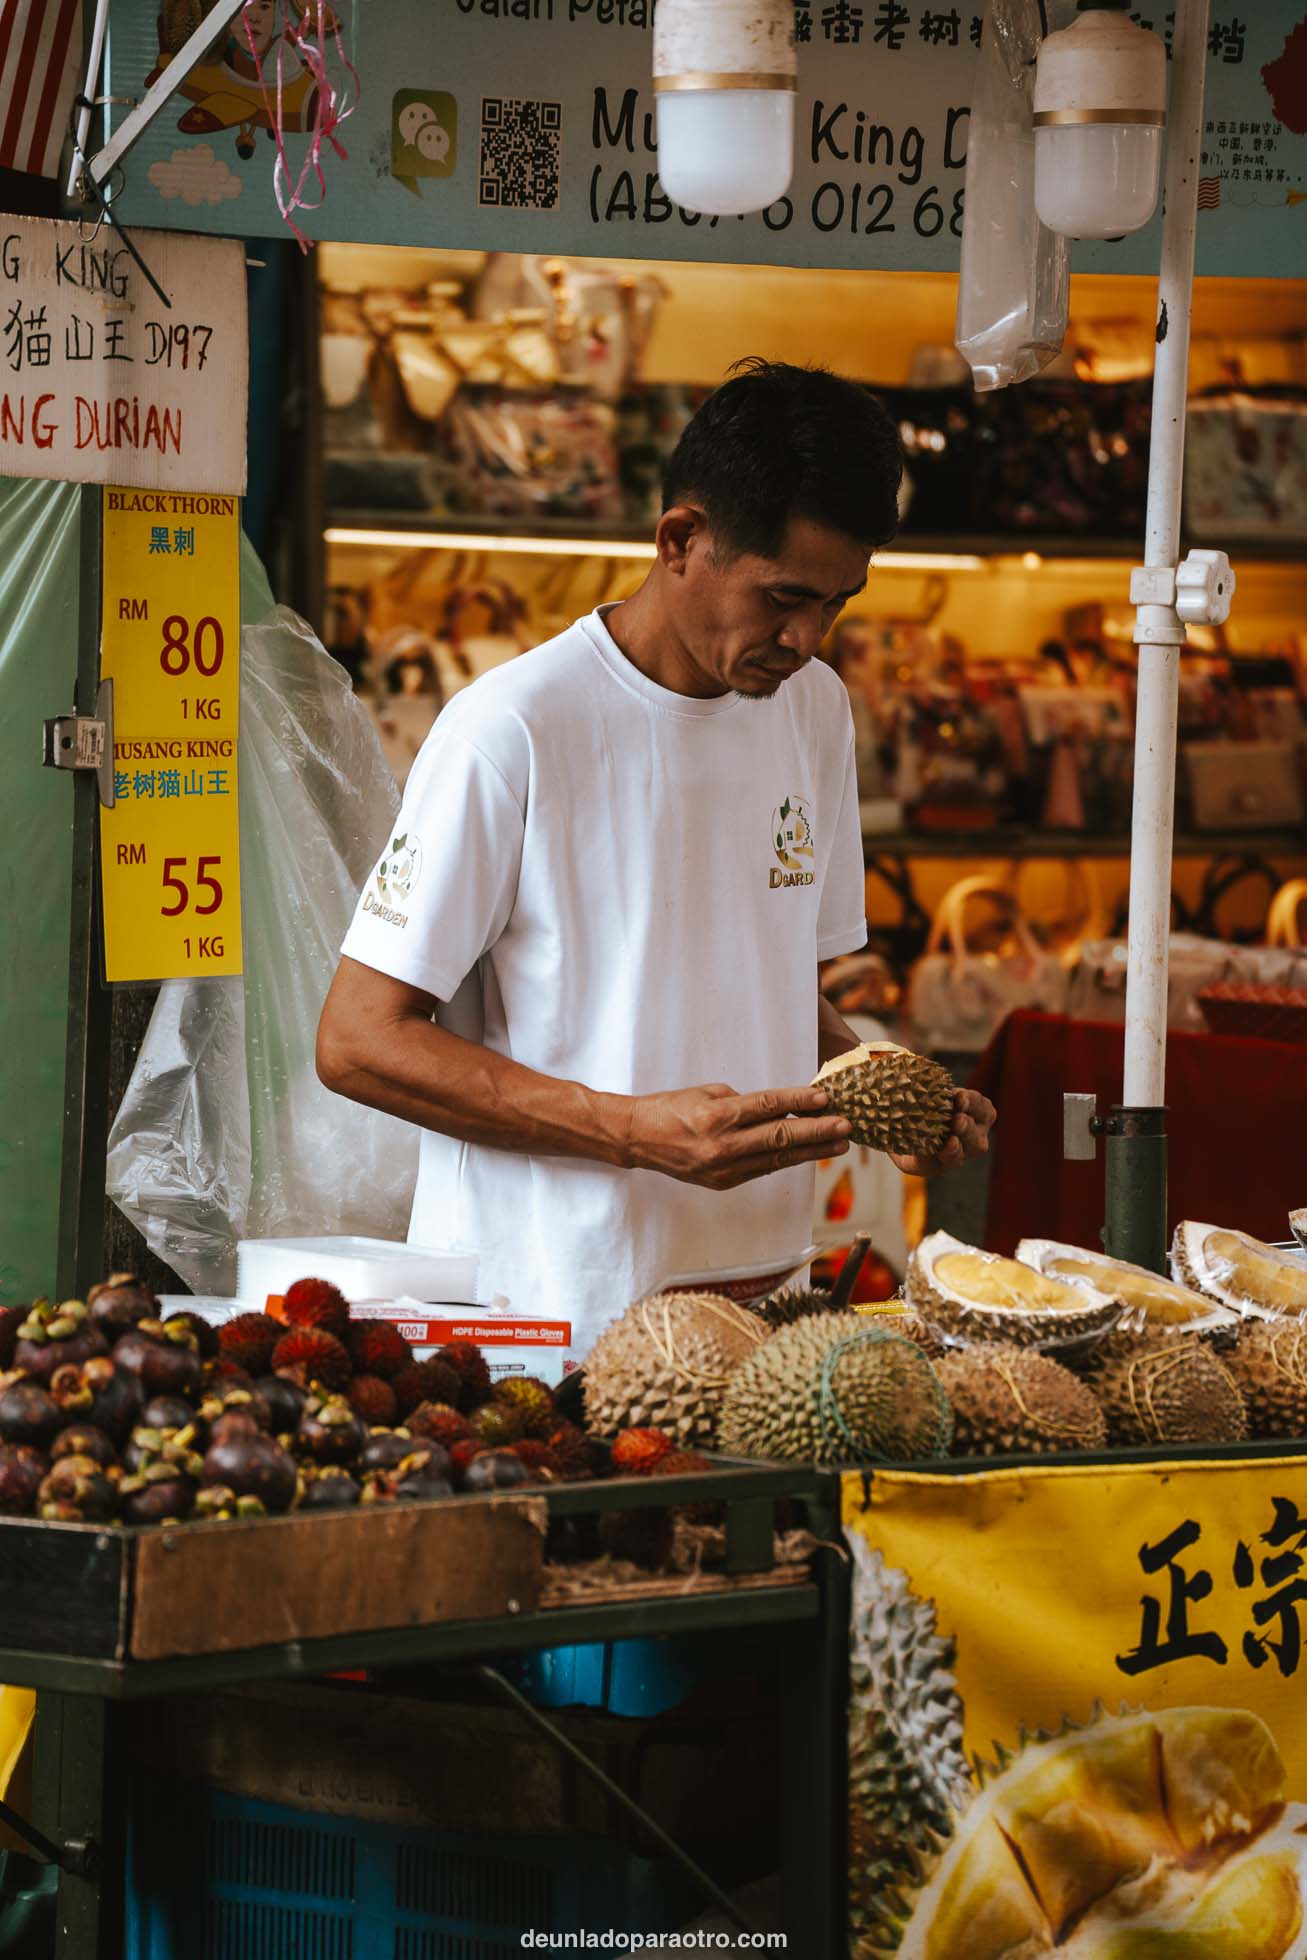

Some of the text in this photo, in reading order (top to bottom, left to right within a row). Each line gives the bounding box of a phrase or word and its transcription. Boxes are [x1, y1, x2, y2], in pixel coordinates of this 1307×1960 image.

[568, 0, 655, 29] Peta
[811, 100, 924, 185] King
[811, 182, 895, 234] 012
[56, 242, 130, 298] KING
[3, 299, 135, 372] 猫山王
[1, 393, 59, 449] NG
[108, 493, 235, 517] BLACK THORN
[148, 526, 195, 556] 黑刺
[119, 598, 148, 621] RM
[159, 615, 224, 677] 80
[181, 698, 221, 720] 1 KG
[186, 740, 233, 758] KING
[113, 769, 230, 799] 老树猫山王
[117, 844, 146, 865] RM
[161, 856, 223, 917] 55
[183, 936, 225, 959] 1 KG
[452, 1327, 473, 1337] HDPE
[475, 1327, 514, 1339] Disposable
[515, 1328, 538, 1338] Plastic
[540, 1328, 565, 1339] Gloves
